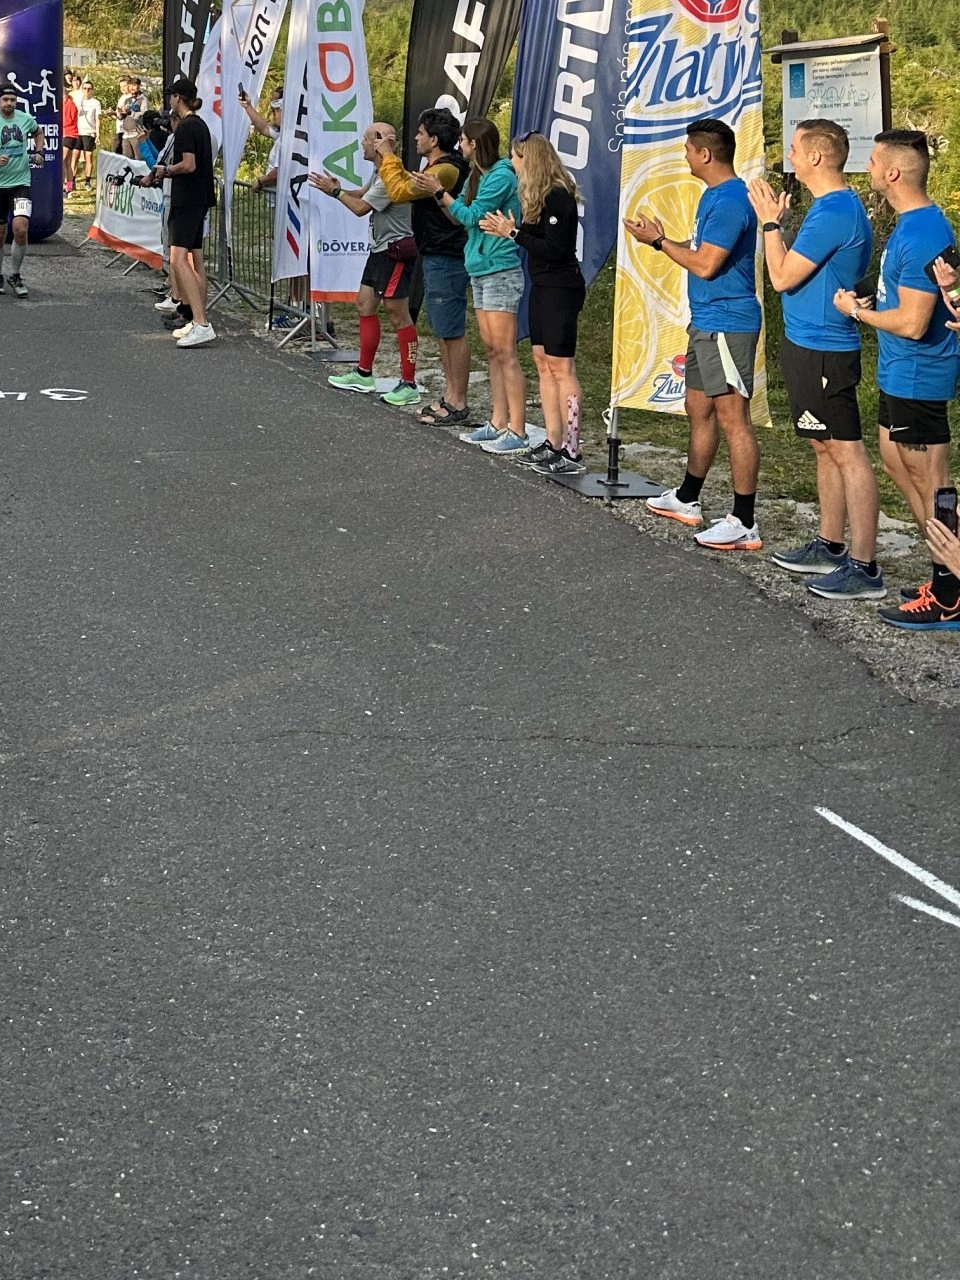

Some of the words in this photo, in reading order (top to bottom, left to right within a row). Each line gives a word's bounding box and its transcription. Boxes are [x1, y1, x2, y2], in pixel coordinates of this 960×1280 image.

[37, 124, 59, 137] TIER
[647, 374, 685, 403] Zlat
[797, 421, 827, 431] adidas
